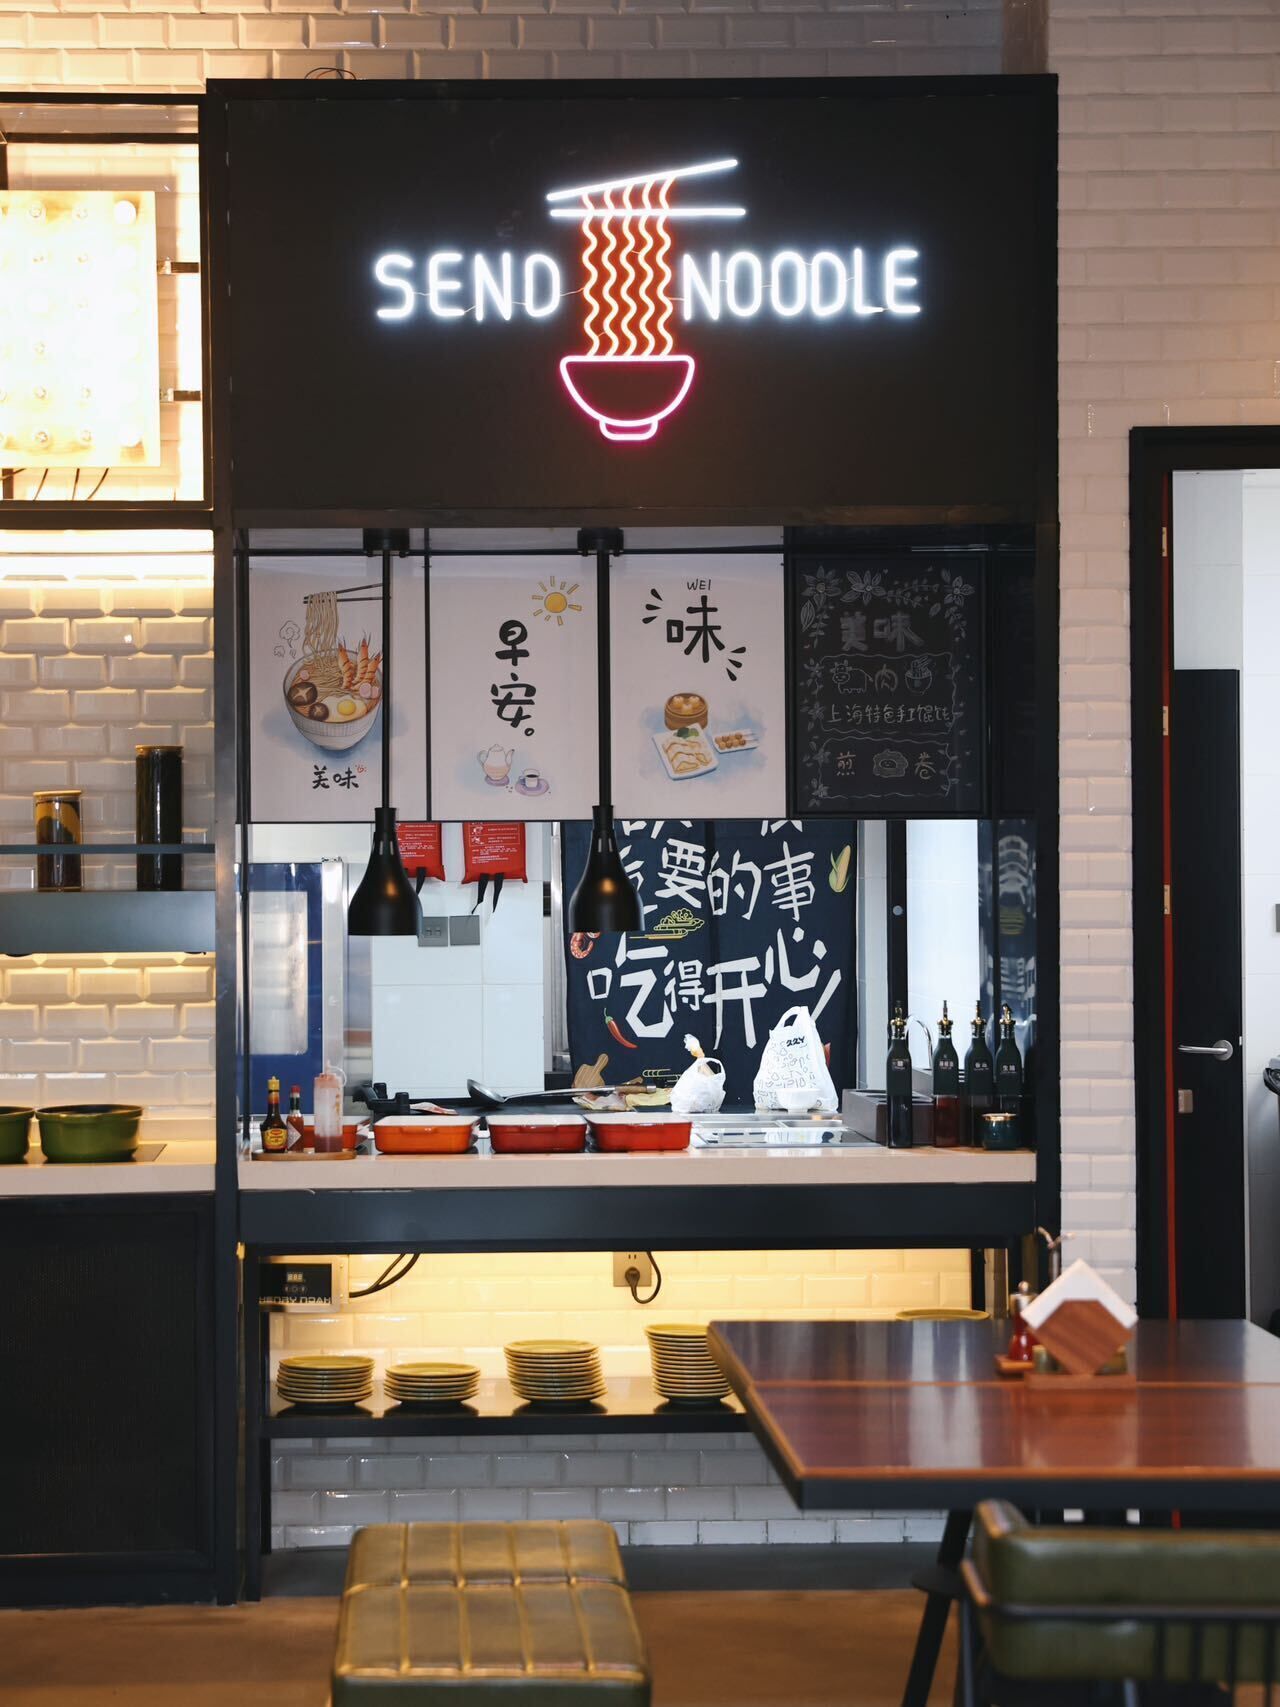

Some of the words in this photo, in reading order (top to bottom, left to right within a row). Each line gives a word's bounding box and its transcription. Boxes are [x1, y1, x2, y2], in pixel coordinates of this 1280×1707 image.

[374, 250, 562, 322] SEND
[681, 248, 922, 322] NOODLE
[686, 578, 713, 592] WEI
[666, 595, 727, 664] 味
[840, 610, 926, 652] 美味
[312, 764, 360, 790] 美味
[586, 927, 829, 1051] 吃得开心
